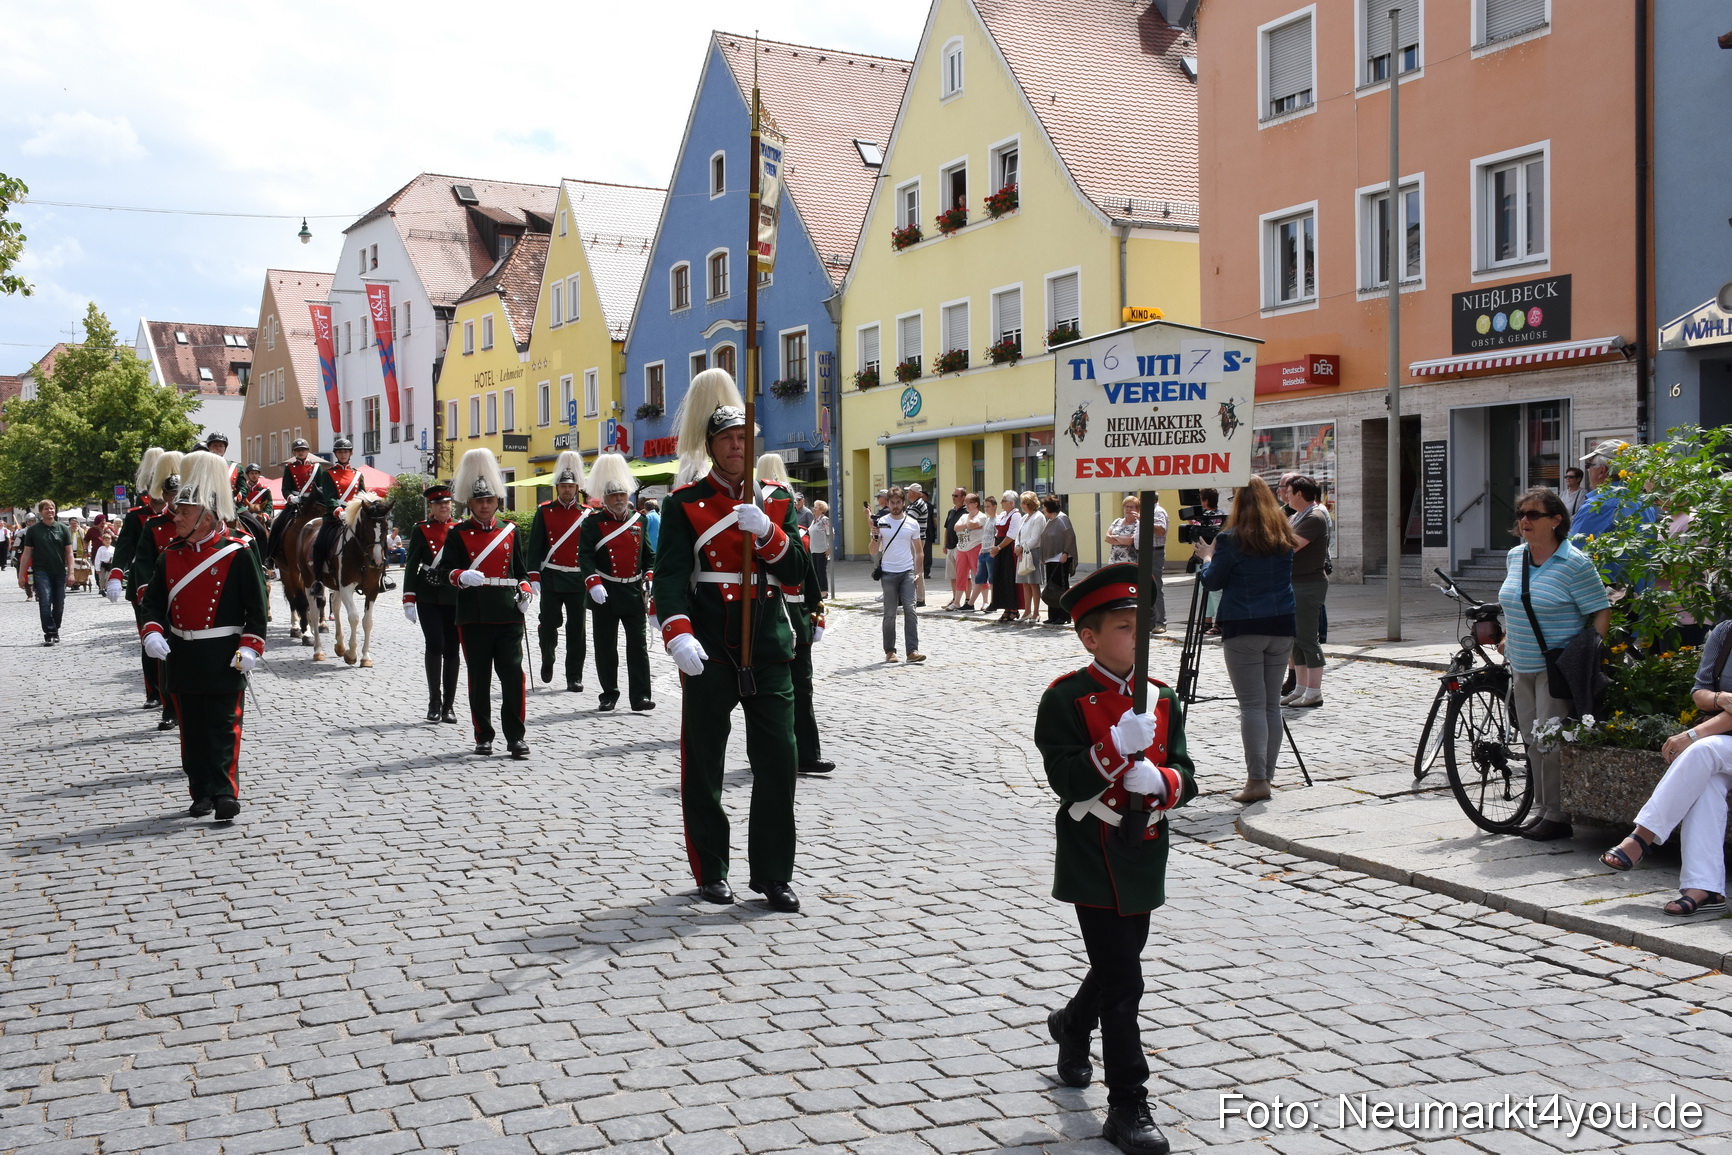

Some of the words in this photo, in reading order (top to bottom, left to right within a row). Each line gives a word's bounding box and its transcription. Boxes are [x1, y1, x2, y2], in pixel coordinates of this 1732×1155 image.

[370, 289, 384, 321] K&L
[1462, 281, 1559, 311] NIEßLBECK
[1131, 310, 1149, 319] KINO
[1471, 337, 1495, 347] OBST
[1498, 336, 1504, 344] &
[1508, 330, 1548, 343] GEMÜSE
[819, 353, 831, 365] CAFÉ
[1103, 344, 1118, 370] 6
[1187, 349, 1212, 375] 7
[1282, 366, 1305, 375] Deutsch
[1313, 359, 1334, 375] DER
[474, 370, 495, 389] HOTEL
[500, 366, 524, 382] Lehmeier
[1282, 377, 1307, 386] Reisebür
[1103, 380, 1207, 404] VEREIN
[1669, 383, 1681, 397] 16
[570, 403, 576, 423] P
[903, 391, 918, 419] FASS
[608, 422, 615, 442] P
[1106, 414, 1203, 432] NEUMARKTER
[553, 435, 570, 448] TAIFU
[1104, 429, 1207, 448] CHEVAULEGERS
[1075, 452, 1231, 479] ESKADRON
